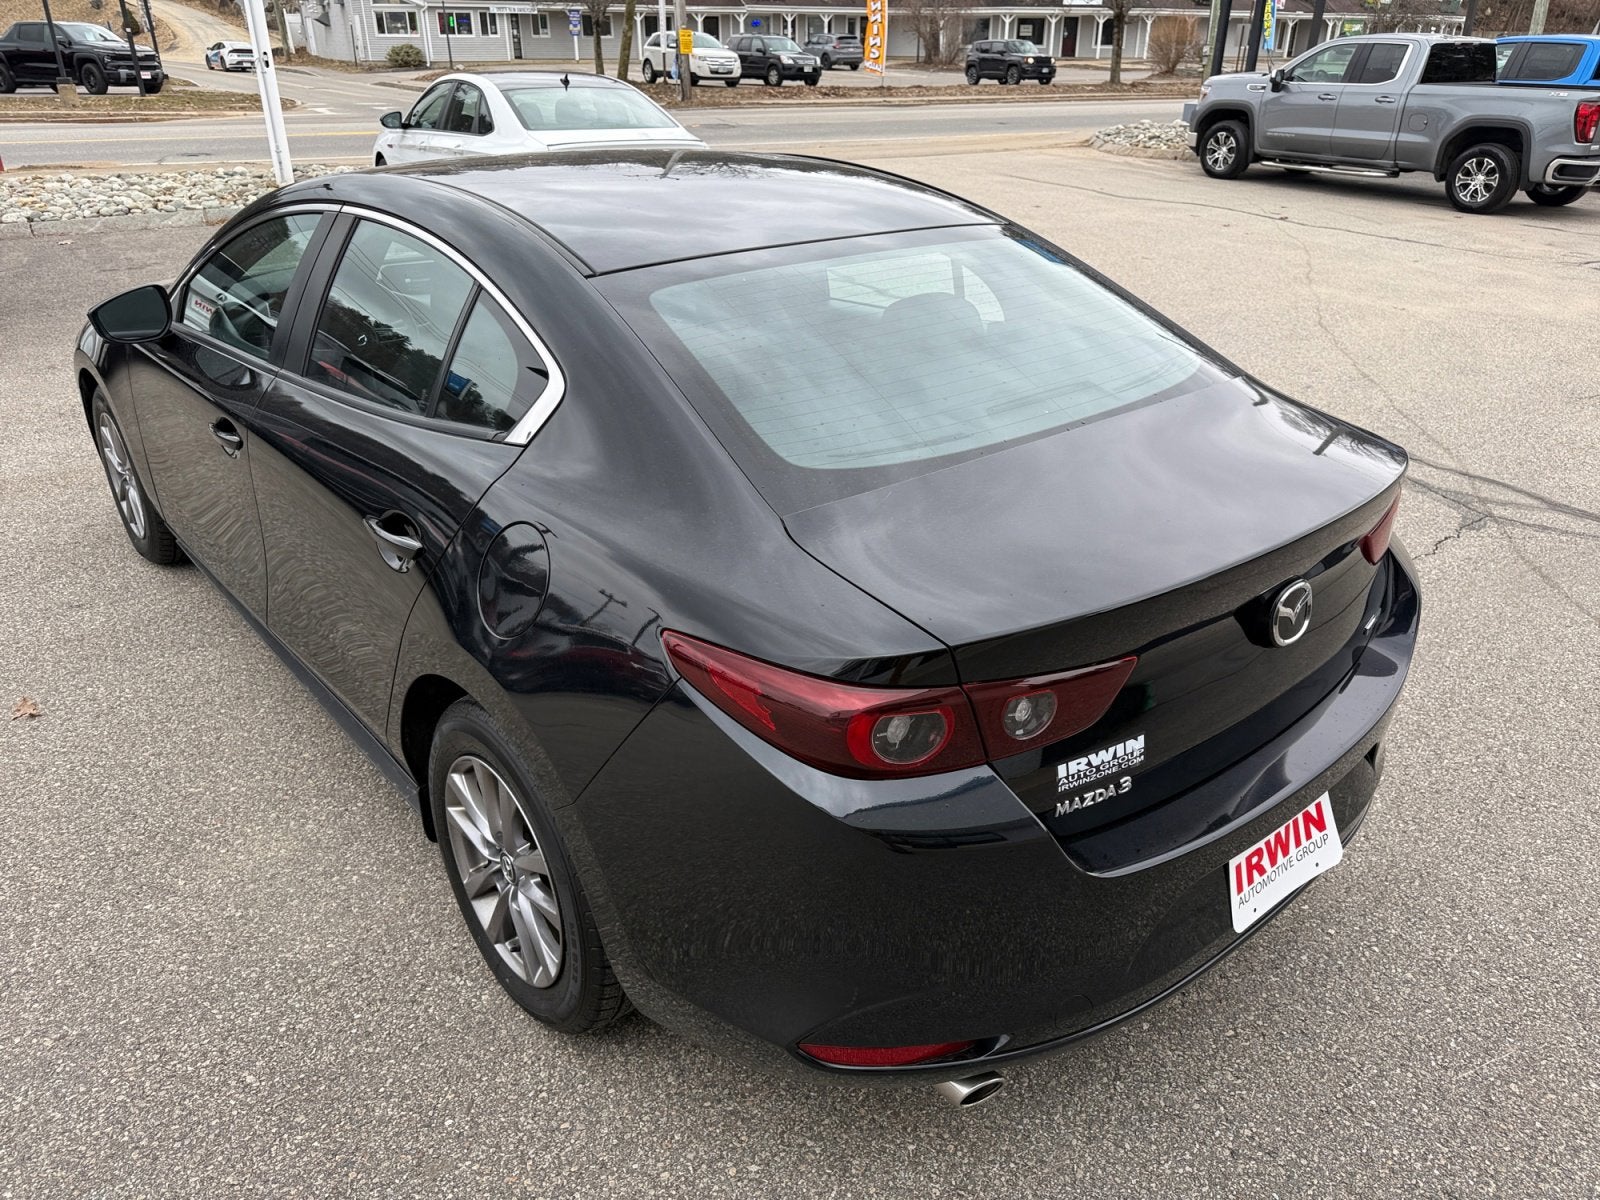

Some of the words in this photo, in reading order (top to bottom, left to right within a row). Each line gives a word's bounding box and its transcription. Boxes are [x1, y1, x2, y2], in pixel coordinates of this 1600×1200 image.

[1057, 734, 1145, 779] IRWIN
[1057, 755, 1145, 793] IRWINZONE.COM
[1058, 767, 1096, 786] AUTO
[1099, 748, 1145, 771] GROUP
[1235, 801, 1327, 896] IRWIN
[1238, 856, 1295, 909] AUTOMOTIVE
[1295, 833, 1329, 862] GROUP
